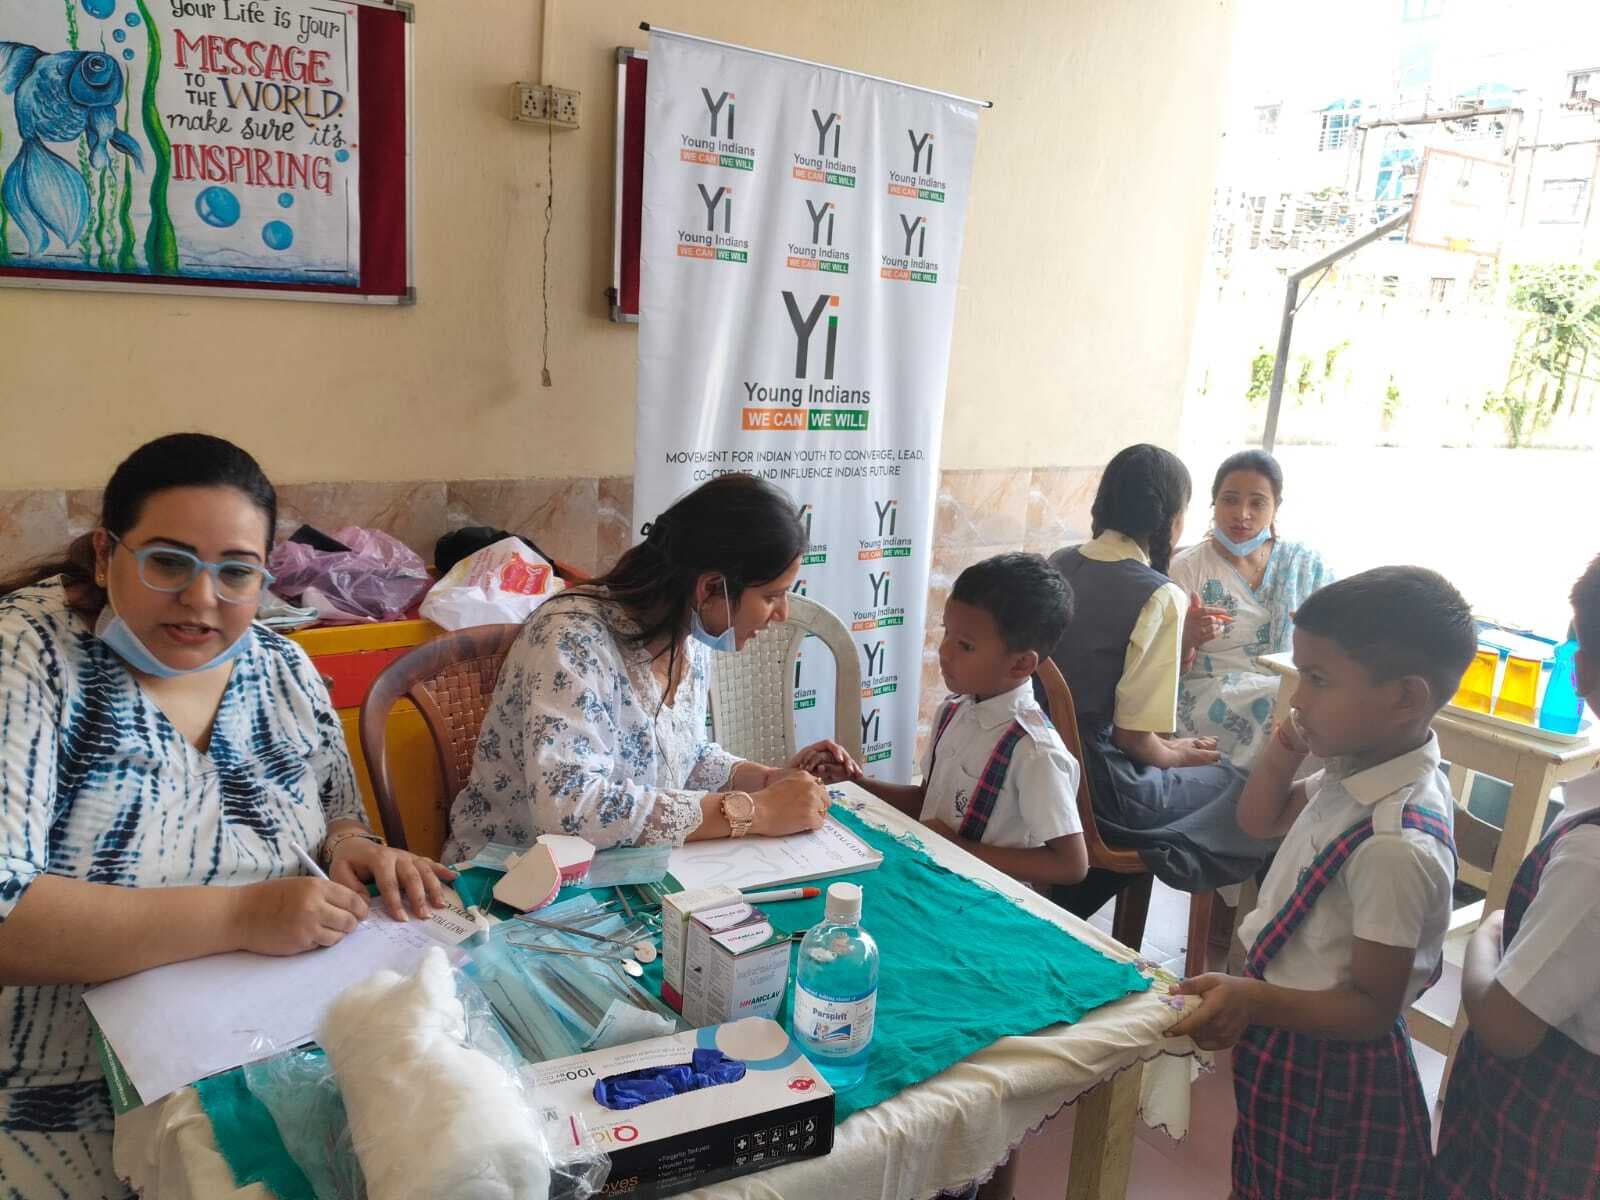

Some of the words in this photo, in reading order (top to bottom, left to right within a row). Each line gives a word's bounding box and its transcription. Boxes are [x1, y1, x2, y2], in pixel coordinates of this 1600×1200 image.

[224, 0, 265, 23] Life
[273, 6, 291, 29] is
[297, 14, 340, 43] your
[173, 28, 333, 86] MESSAGE
[184, 72, 206, 88] TO
[185, 90, 217, 107] THE
[217, 76, 343, 127] WORLD.
[702, 87, 736, 140] Yi
[167, 109, 232, 134] make
[240, 117, 295, 141] sure
[310, 124, 346, 148] it's
[681, 134, 715, 152] Young
[719, 142, 755, 156] Indians
[812, 109, 842, 158] Yi
[172, 144, 333, 194] INSPIRING
[794, 153, 823, 169] Young
[825, 159, 857, 173] Indians
[908, 129, 934, 175] Yi
[889, 170, 916, 186] Young
[919, 176, 946, 189] Indians
[698, 184, 732, 233] Yi
[806, 200, 835, 245] Yi
[678, 230, 712, 247] Young
[715, 235, 749, 249] Indians
[788, 243, 816, 258] Young
[819, 248, 850, 260] Indians
[900, 214, 928, 258] Yi
[882, 256, 908, 269] Young
[911, 259, 938, 271] Indians
[781, 290, 840, 380] Yi
[744, 382, 803, 407] Young
[809, 384, 871, 404] Indians
[748, 412, 770, 427] WE
[774, 413, 803, 427] CAN
[811, 413, 832, 427] WE
[835, 413, 866, 427] WILL
[666, 451, 729, 464] MOVEMENT
[732, 451, 754, 463] FOR
[757, 451, 792, 462] INDIAN
[794, 450, 826, 461] YOUTH
[829, 450, 842, 461] TO
[844, 449, 896, 461] CONVERGE,
[757, 469, 778, 480] AND
[780, 467, 833, 479] INFLUENCE
[835, 466, 867, 477] INDIA'S
[870, 465, 901, 476] FUTURE
[875, 500, 897, 536] Yi
[860, 539, 880, 548] Young
[882, 537, 911, 546] Indians
[869, 571, 890, 607] Yi
[853, 609, 877, 620] Young
[878, 608, 904, 617] Indians
[864, 641, 885, 676] Yi
[567, 1066, 597, 1081] 100
